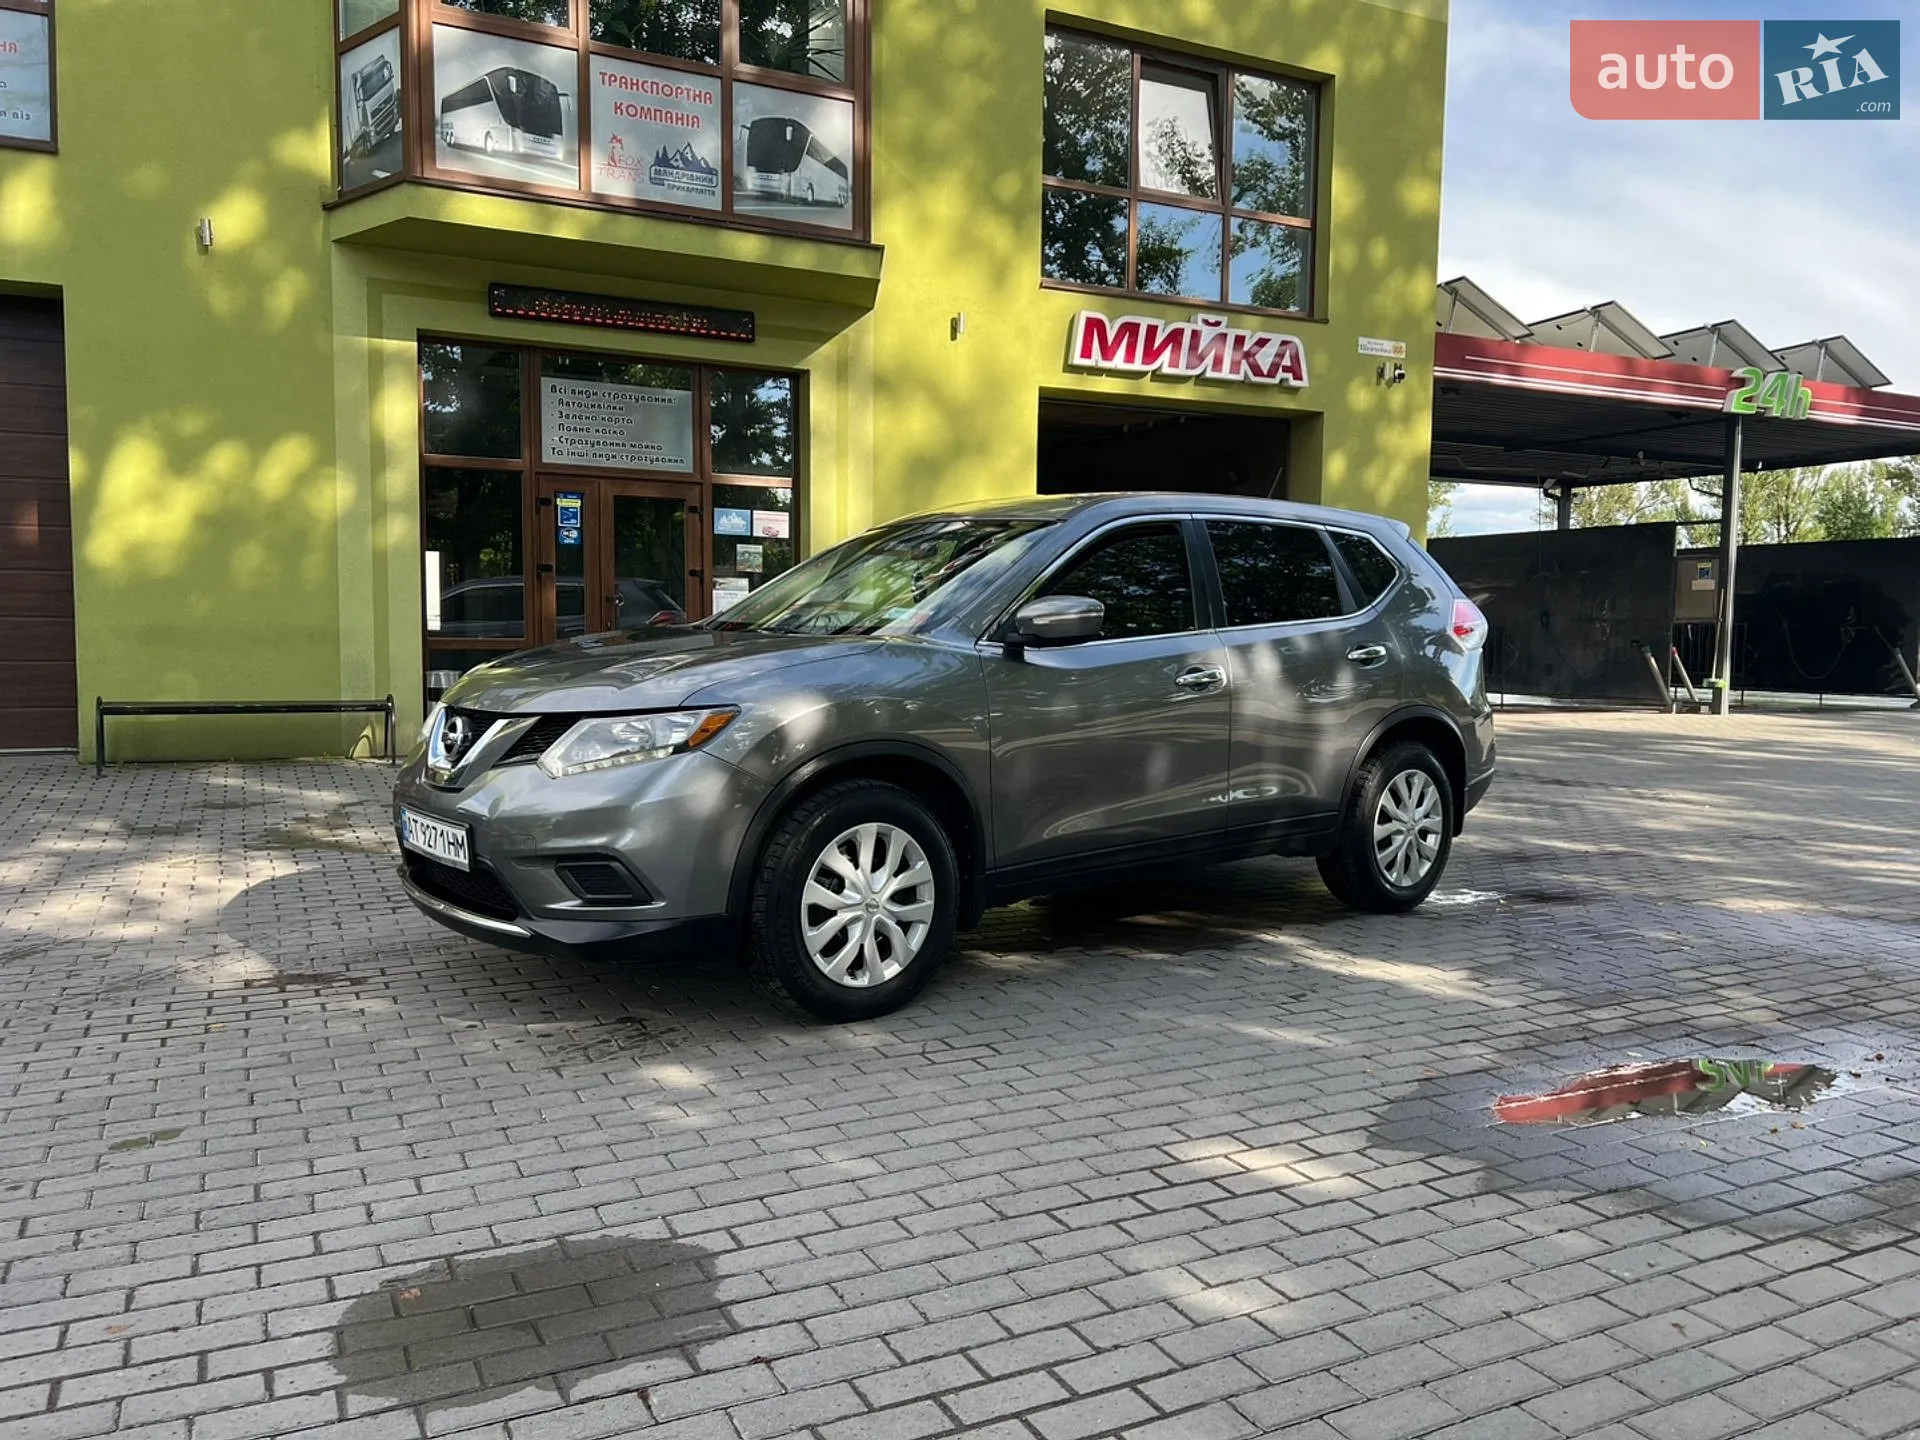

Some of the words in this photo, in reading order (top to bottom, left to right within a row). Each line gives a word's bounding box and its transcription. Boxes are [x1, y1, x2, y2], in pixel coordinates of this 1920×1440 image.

[598, 71, 713, 105] ТРАНСПОРТНА
[613, 101, 701, 129] КОМПАНІЯ
[618, 154, 644, 169] FOX
[596, 167, 645, 184] TRANS
[1079, 316, 1305, 382] МИЙКА
[550, 384, 567, 394] Всі
[570, 389, 598, 399] види
[1726, 367, 1812, 419] 24h
[595, 428, 626, 436] каско
[551, 446, 564, 456] Та
[592, 452, 617, 462] види
